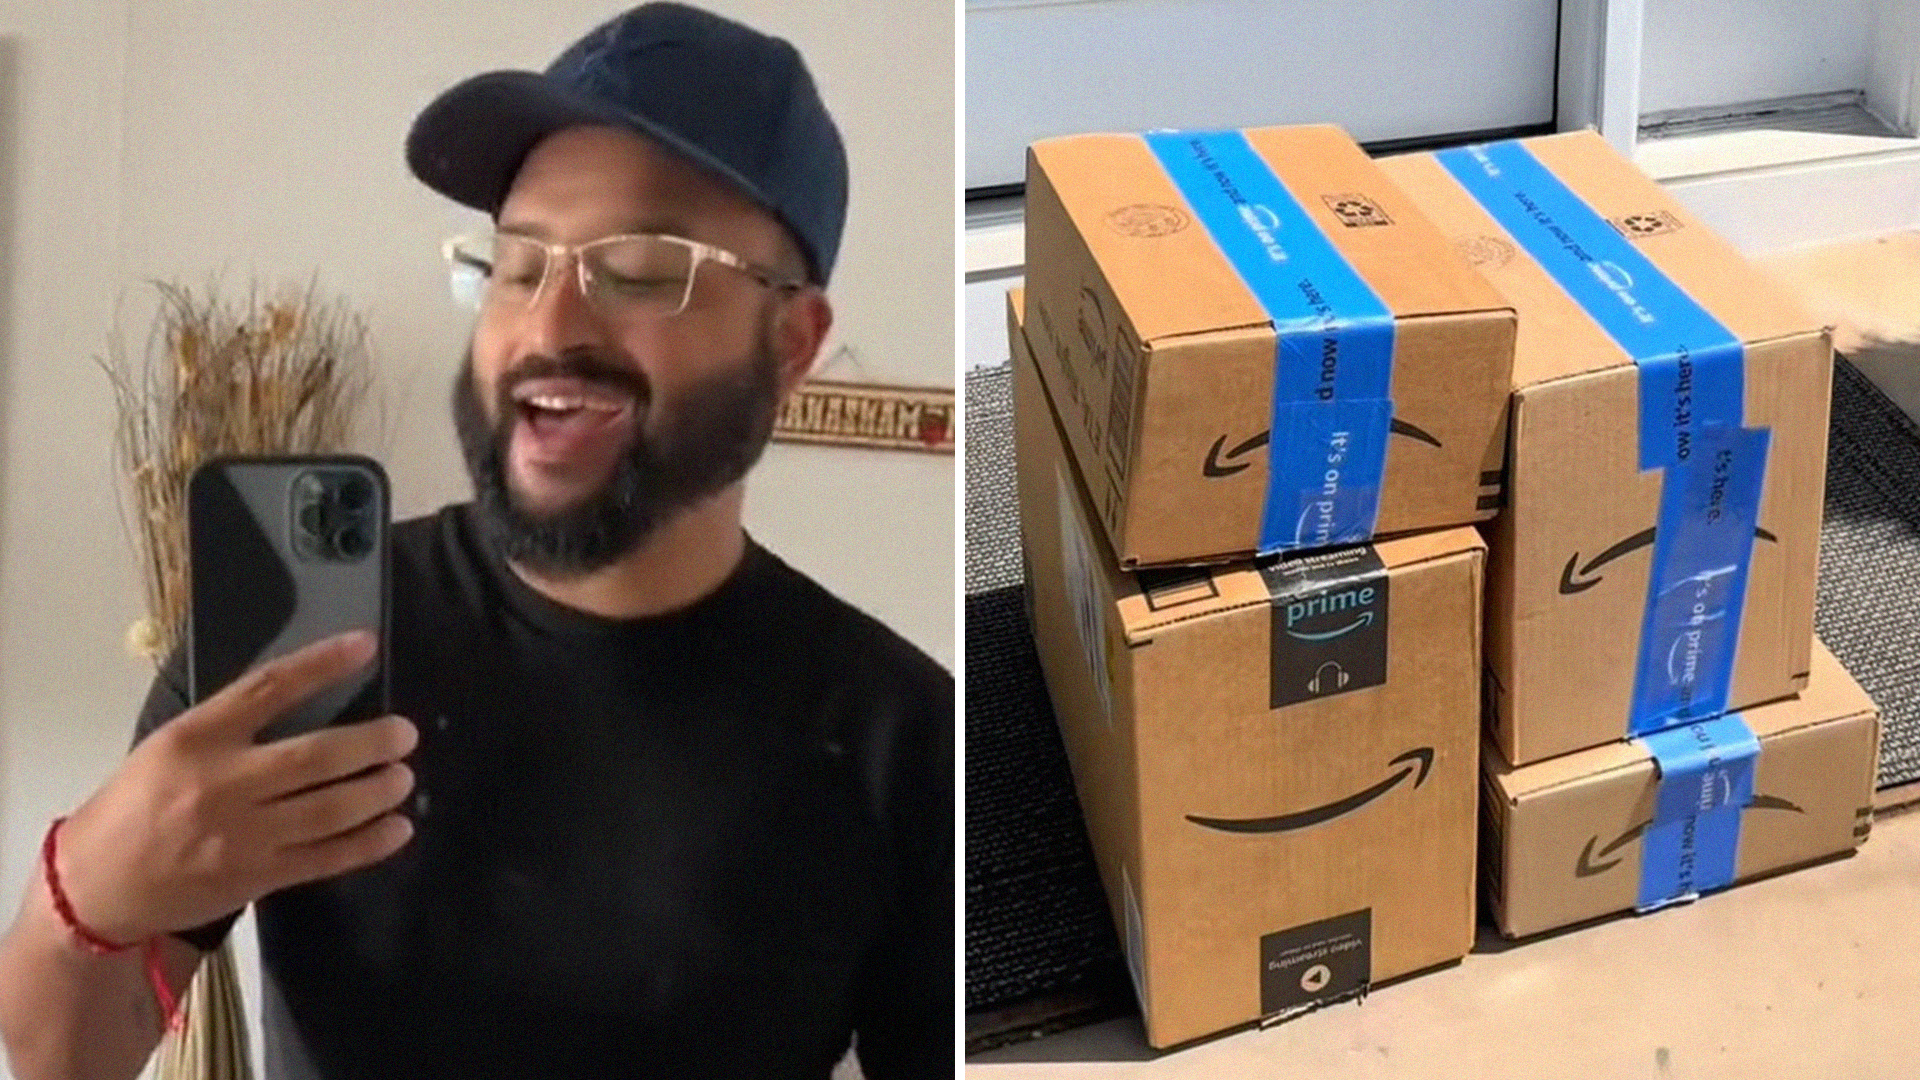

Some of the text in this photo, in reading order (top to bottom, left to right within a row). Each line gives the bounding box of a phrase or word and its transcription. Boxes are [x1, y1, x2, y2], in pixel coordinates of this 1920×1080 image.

[1321, 337, 1338, 382] now
[1673, 396, 1692, 428] it's
[1677, 431, 1691, 460] ow
[1315, 431, 1349, 543] It's on prim
[1304, 547, 1367, 563] streaming
[1287, 587, 1375, 627] prime
[1682, 630, 1703, 682] prime
[1700, 771, 1716, 811] rime
